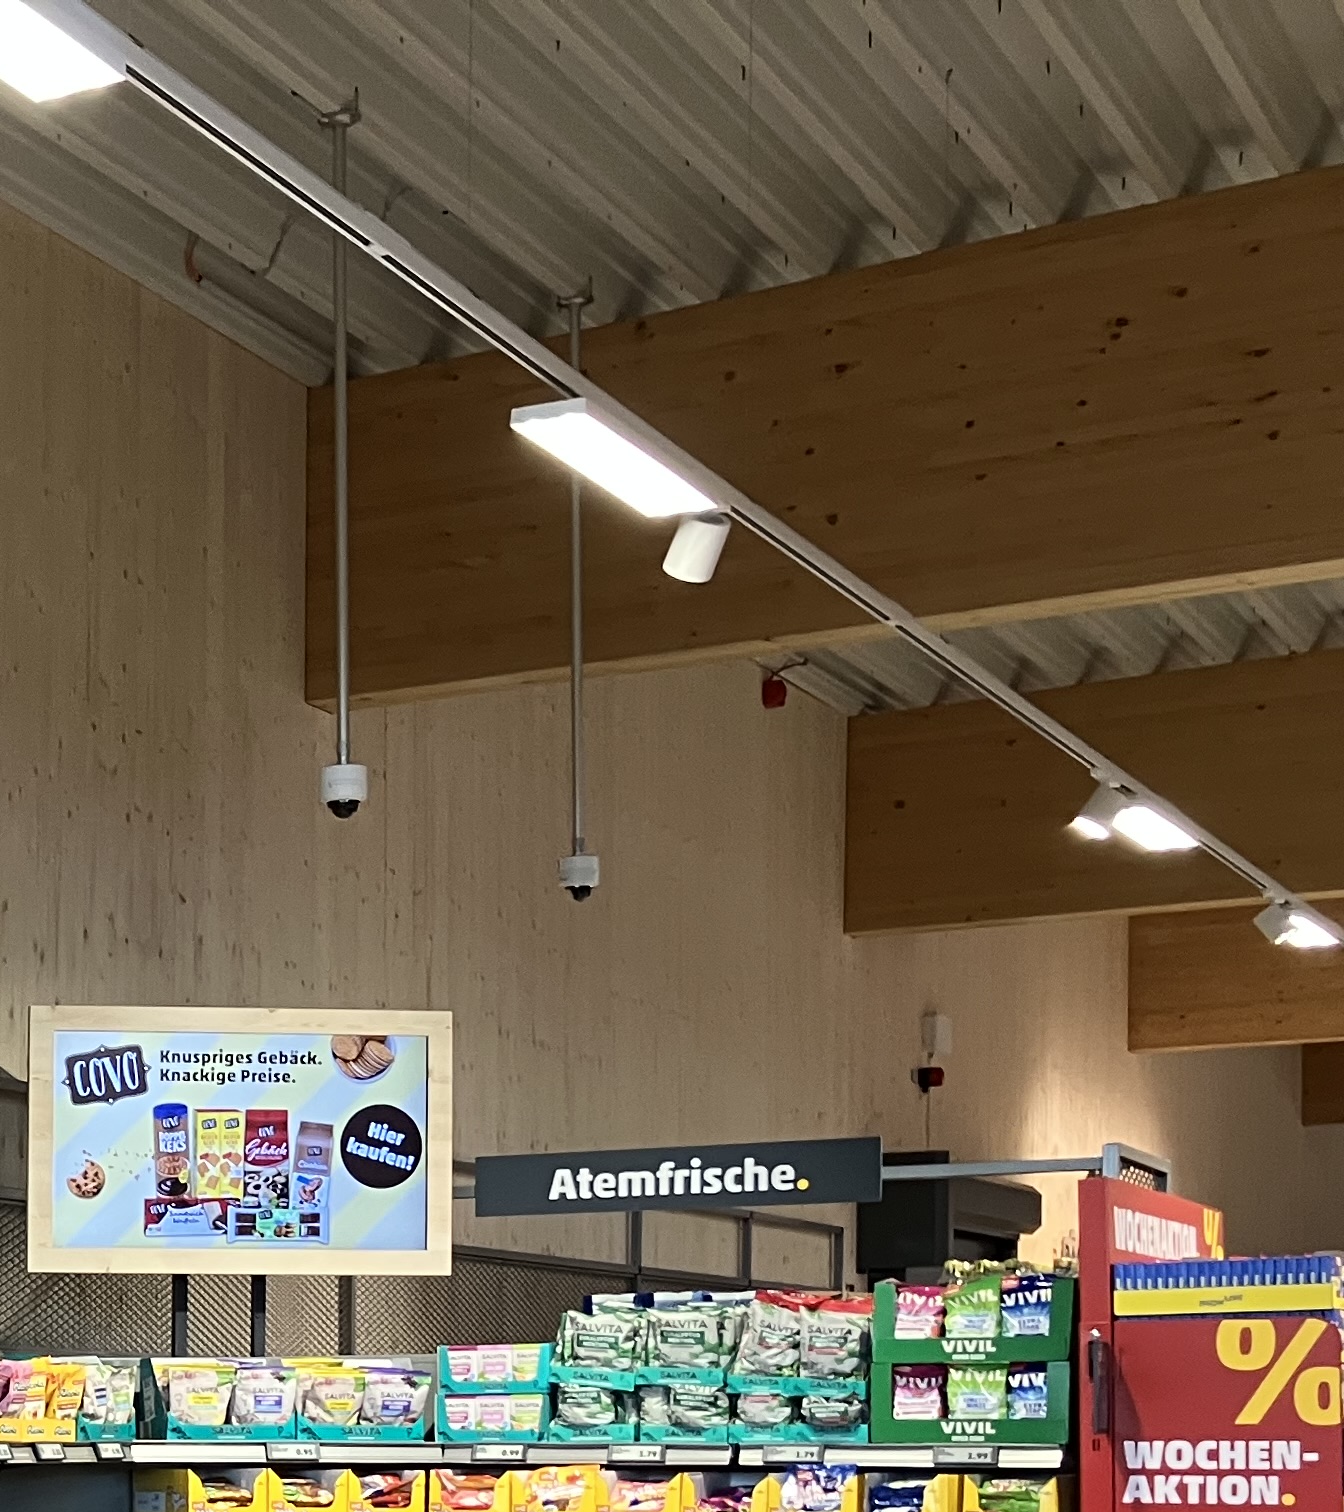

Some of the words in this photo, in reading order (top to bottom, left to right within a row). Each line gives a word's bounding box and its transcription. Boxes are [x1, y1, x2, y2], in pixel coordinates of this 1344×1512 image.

[160, 1049, 253, 1067] Knuspriges
[258, 1049, 323, 1066] Gebäck.
[73, 1051, 141, 1098] COVO
[160, 1068, 236, 1085] Knackige
[241, 1068, 297, 1084] Preise.
[367, 1121, 405, 1145] Hier
[346, 1139, 414, 1171] kaufen!
[548, 1157, 810, 1201] Atemfrische.
[656, 1318, 708, 1331] SALVITA
[942, 1340, 996, 1353] VIVIL
[1216, 1319, 1342, 1426] %
[940, 1421, 996, 1434] VIVIL
[1124, 1440, 1319, 1470] WOCHEN-
[1123, 1475, 1296, 1506] AKTION.
